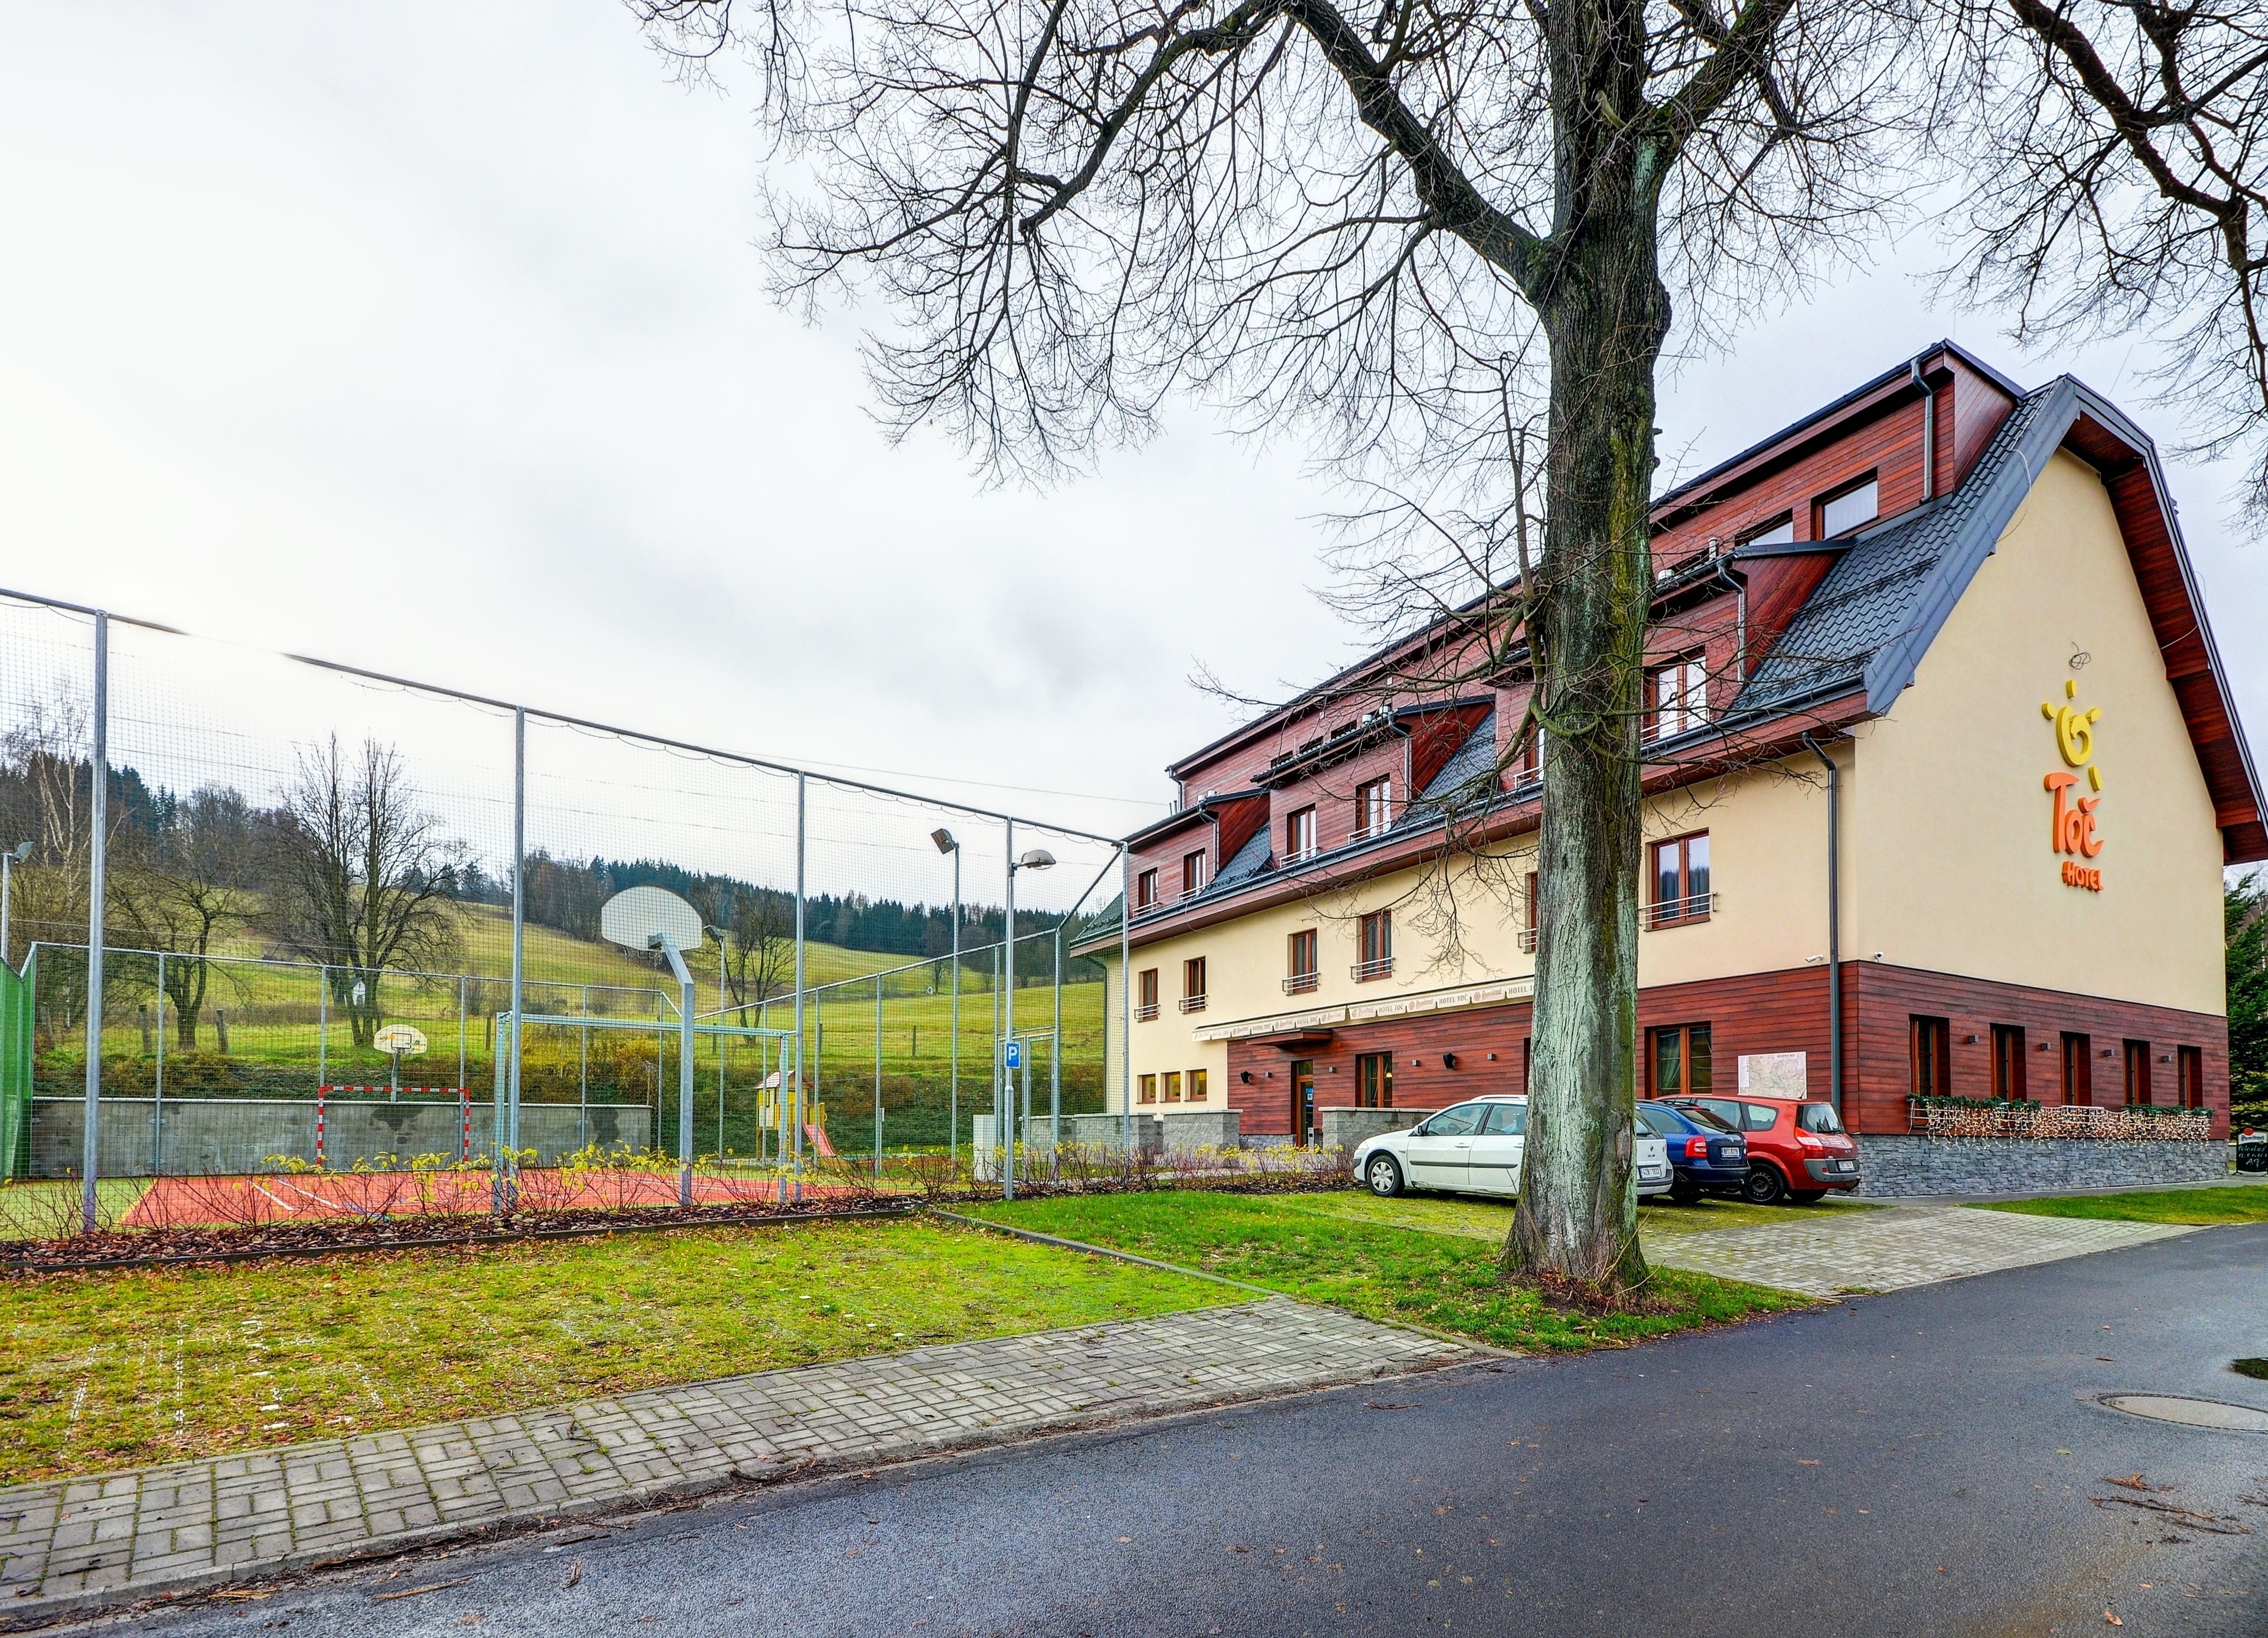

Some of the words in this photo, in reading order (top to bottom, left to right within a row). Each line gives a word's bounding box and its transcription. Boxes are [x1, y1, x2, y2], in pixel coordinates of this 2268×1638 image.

[2062, 861, 2104, 892] HOTEL
[1508, 986, 1527, 994] HOTEL
[1457, 994, 1467, 1002] TOČ
[1008, 1046, 1017, 1061] P
